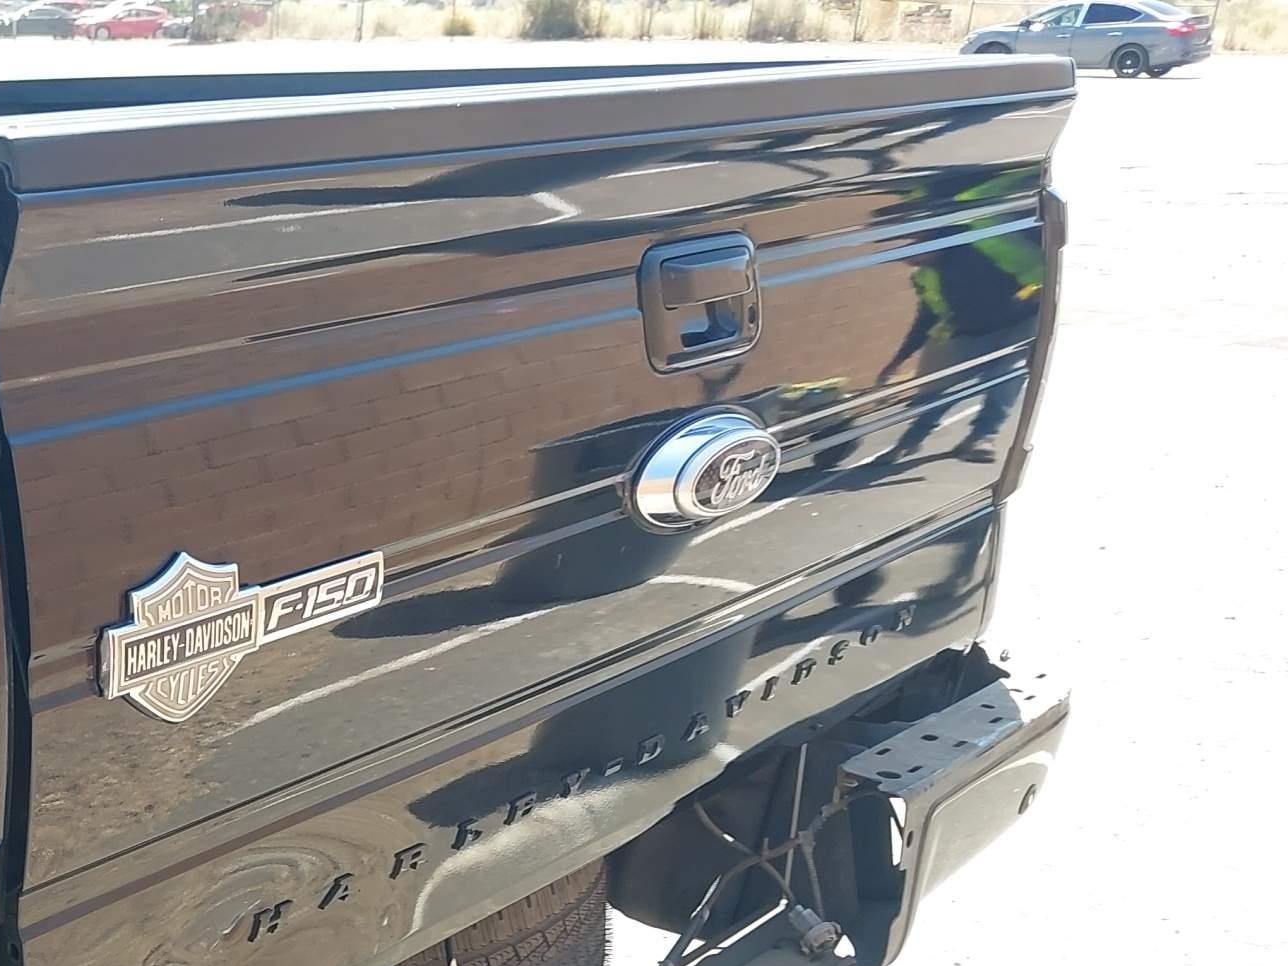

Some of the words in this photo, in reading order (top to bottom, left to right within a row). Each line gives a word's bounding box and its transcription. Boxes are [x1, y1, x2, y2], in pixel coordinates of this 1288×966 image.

[710, 449, 773, 505] Ford
[158, 578, 223, 624] MOTOR
[266, 567, 377, 632] F-150
[126, 609, 251, 676] HARLEY-DAVIDSON
[156, 659, 222, 705] CYCLES
